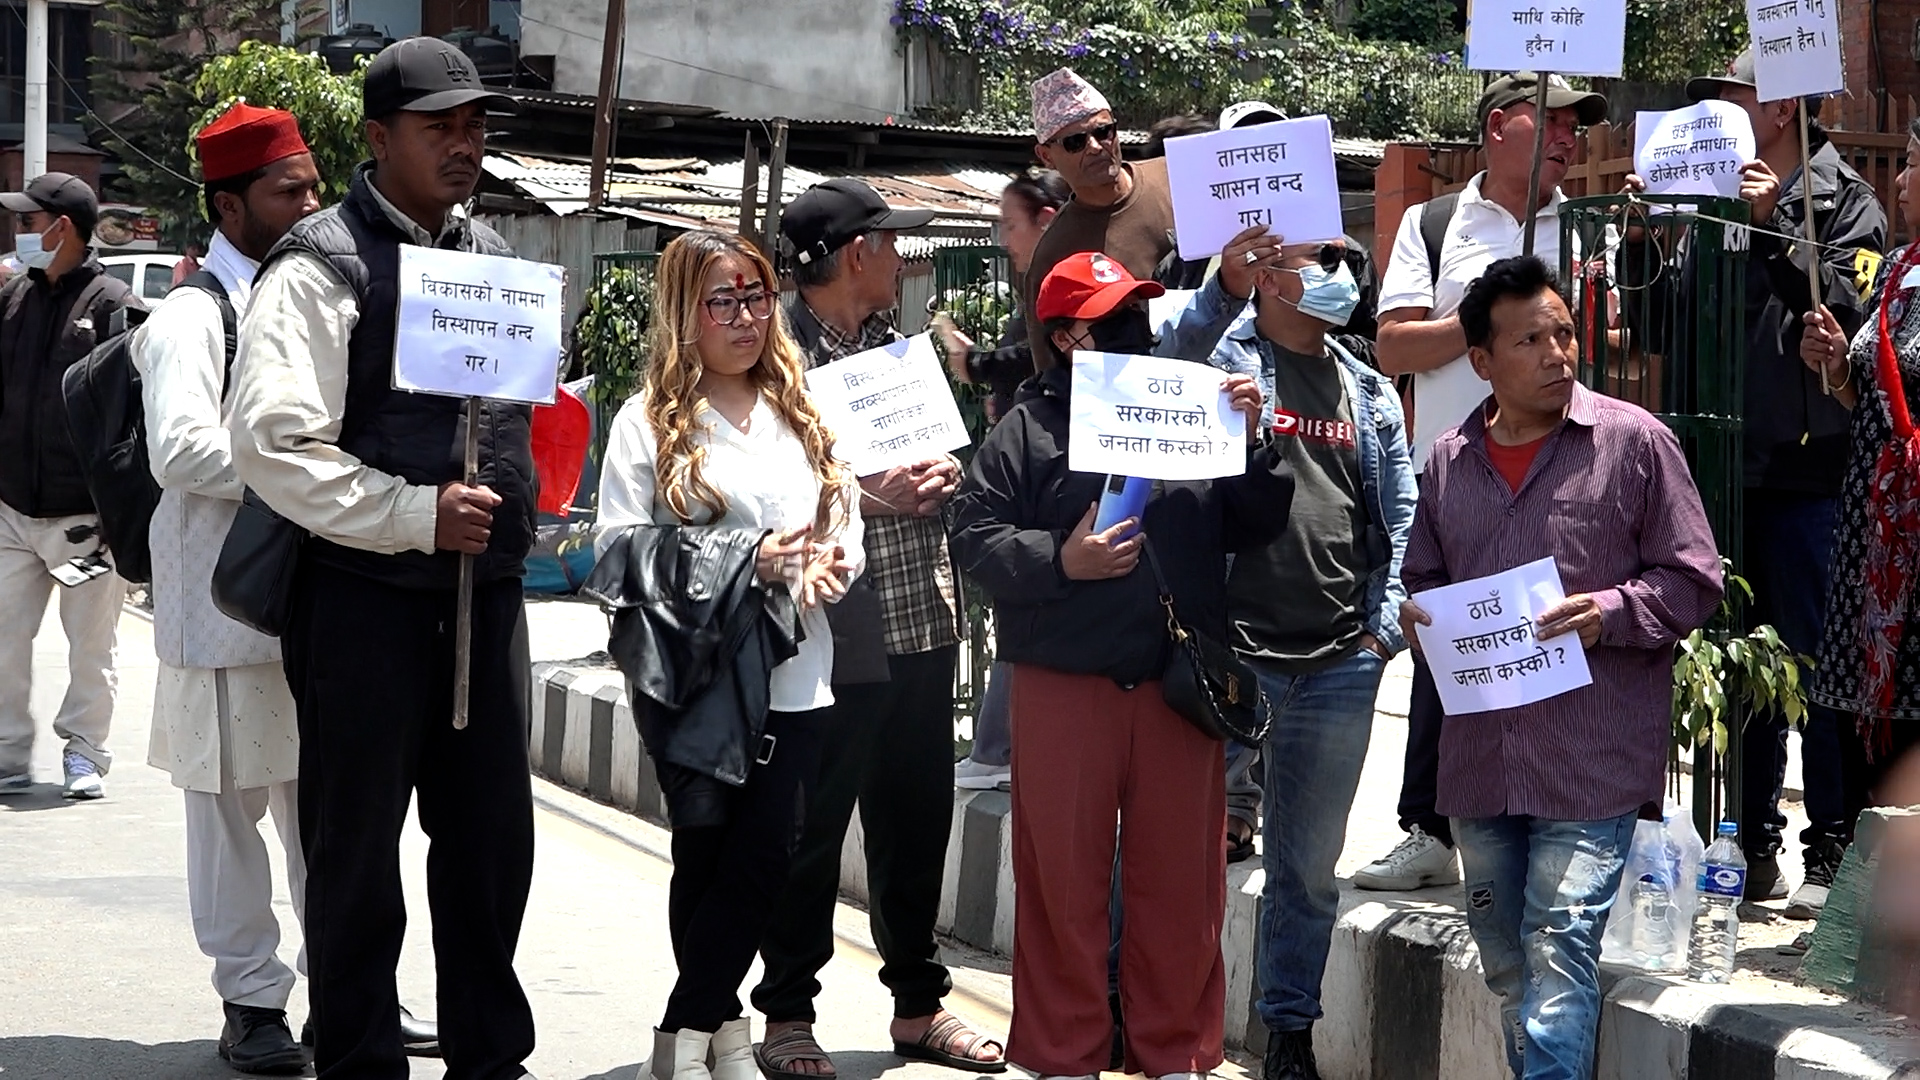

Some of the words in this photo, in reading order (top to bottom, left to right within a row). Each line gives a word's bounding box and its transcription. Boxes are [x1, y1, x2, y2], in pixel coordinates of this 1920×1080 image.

[1512, 7, 1544, 25] माथि
[1551, 7, 1585, 26] कोहि
[1526, 34, 1554, 57] हुदैन
[1797, 26, 1816, 52] हैन
[1216, 142, 1288, 168] तानसहा
[1690, 137, 1738, 155] समाधान
[1649, 160, 1689, 183] डोजेरले
[1718, 160, 1727, 174] र
[1209, 177, 1261, 200] शासन
[1265, 172, 1303, 193] बन्द
[421, 273, 493, 303] विकासको
[501, 288, 546, 309] नाममा
[432, 308, 499, 338] विस्थापन
[465, 354, 488, 373] गर
[1147, 374, 1185, 396] ठाउँ
[1298, 416, 1352, 441] DIESEL
[1098, 433, 1151, 454] जनता
[1156, 435, 1213, 456] कस्को
[1467, 589, 1503, 620] ठाउँ
[1452, 666, 1494, 687] जनता
[1495, 646, 1551, 682] कस्को
